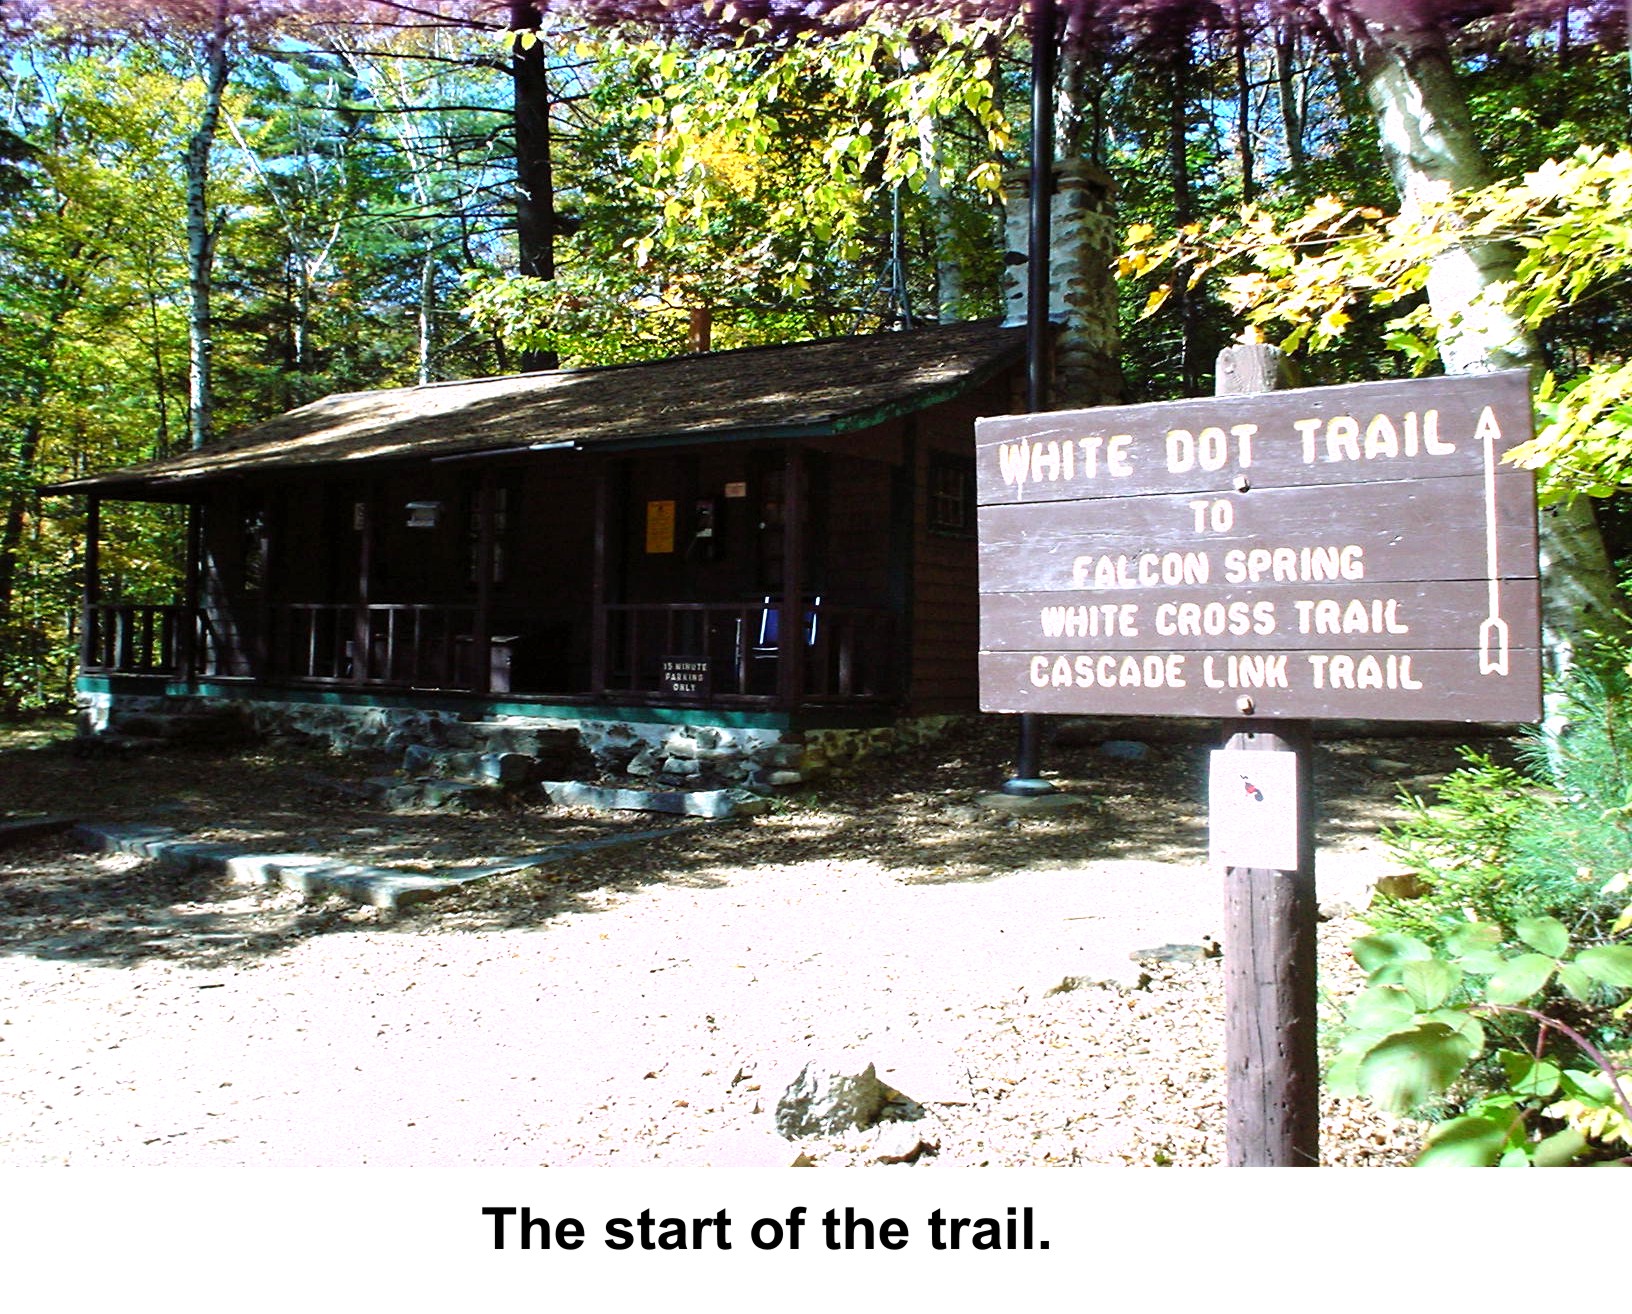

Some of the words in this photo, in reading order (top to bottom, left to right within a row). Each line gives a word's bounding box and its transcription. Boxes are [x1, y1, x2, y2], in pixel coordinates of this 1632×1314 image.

[999, 434, 1134, 485] WHITE
[1165, 423, 1258, 474] DOT
[1293, 409, 1456, 463] TRAIL
[1189, 499, 1234, 533] TO
[1072, 552, 1209, 588] FALCON
[1224, 545, 1365, 583] SPRING
[1040, 603, 1140, 638] WHITE
[1155, 601, 1276, 636] CROSS
[1296, 599, 1409, 636] TRAIL
[663, 662, 673, 671] 15
[674, 662, 707, 671] MINUTE
[664, 672, 704, 682] PARKING
[1029, 655, 1186, 689] CASCADE
[1203, 655, 1289, 689] LINK
[1309, 655, 1423, 691] TRAIL
[672, 683, 696, 692] ONLY
